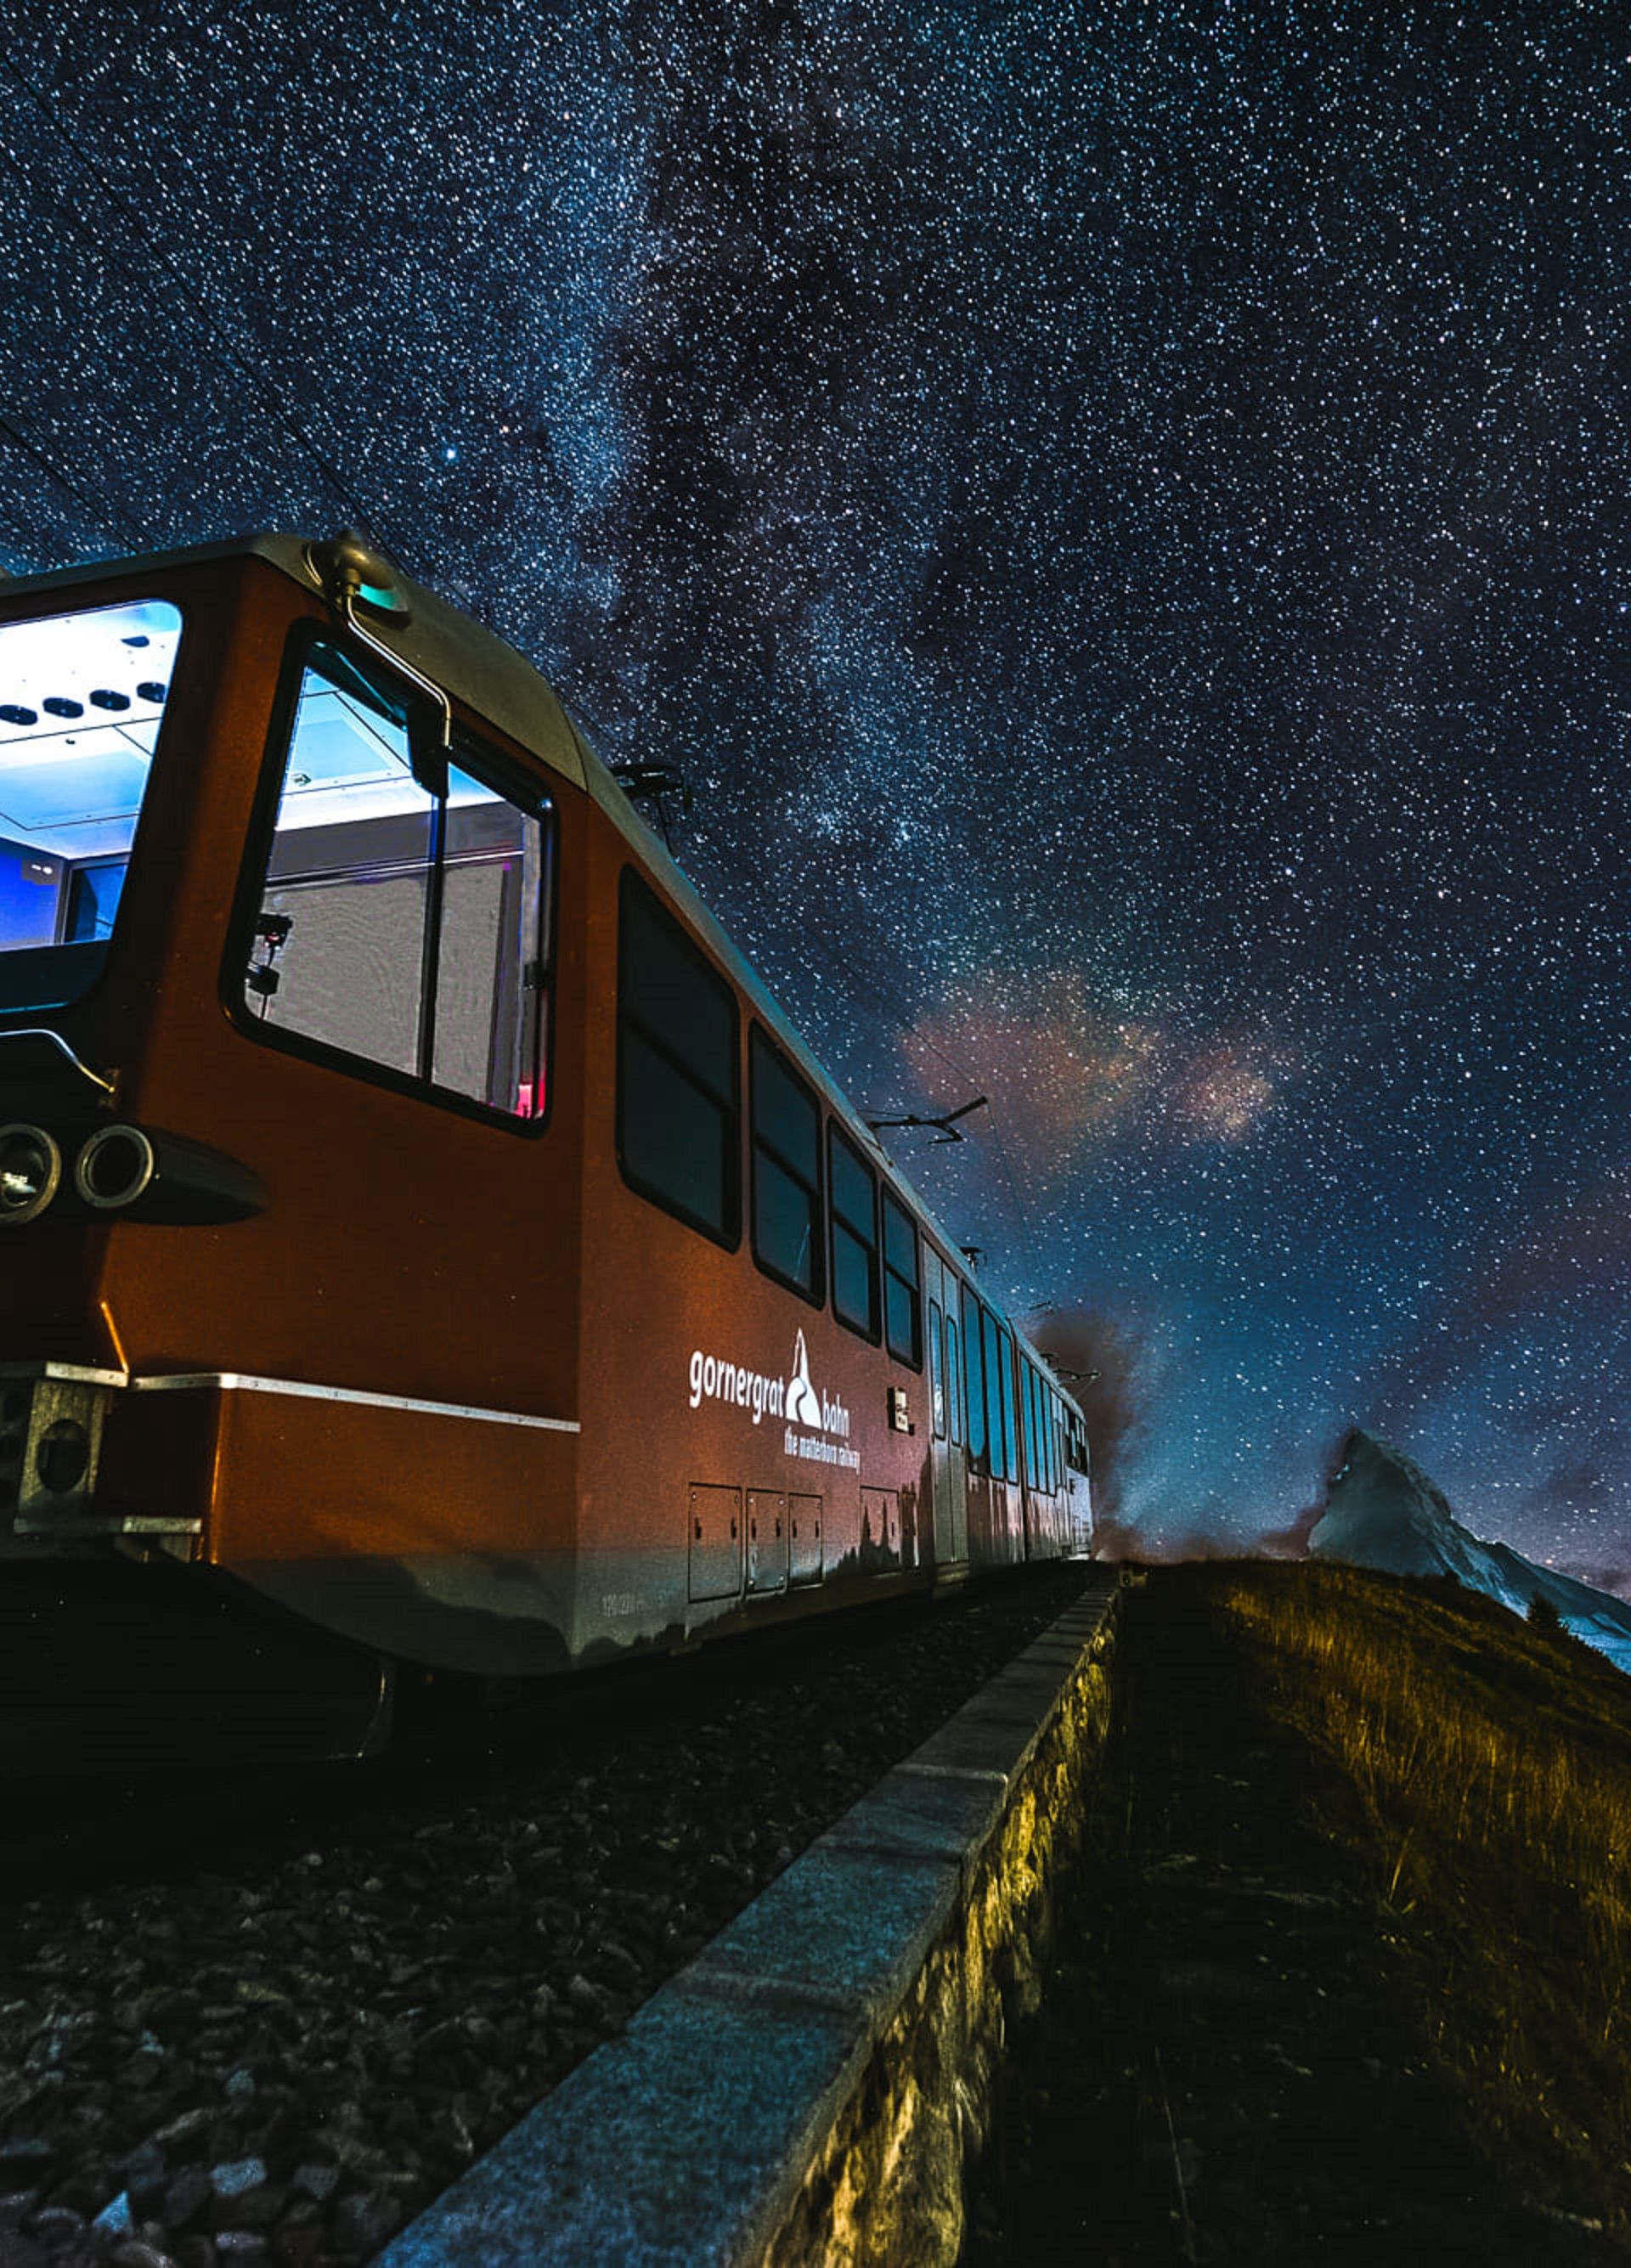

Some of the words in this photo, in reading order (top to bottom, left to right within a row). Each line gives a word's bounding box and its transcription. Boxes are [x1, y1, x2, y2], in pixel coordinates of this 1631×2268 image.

[689, 1350, 784, 1425] gornergrat
[823, 1388, 849, 1438] bahn
[784, 1425, 798, 1456] the
